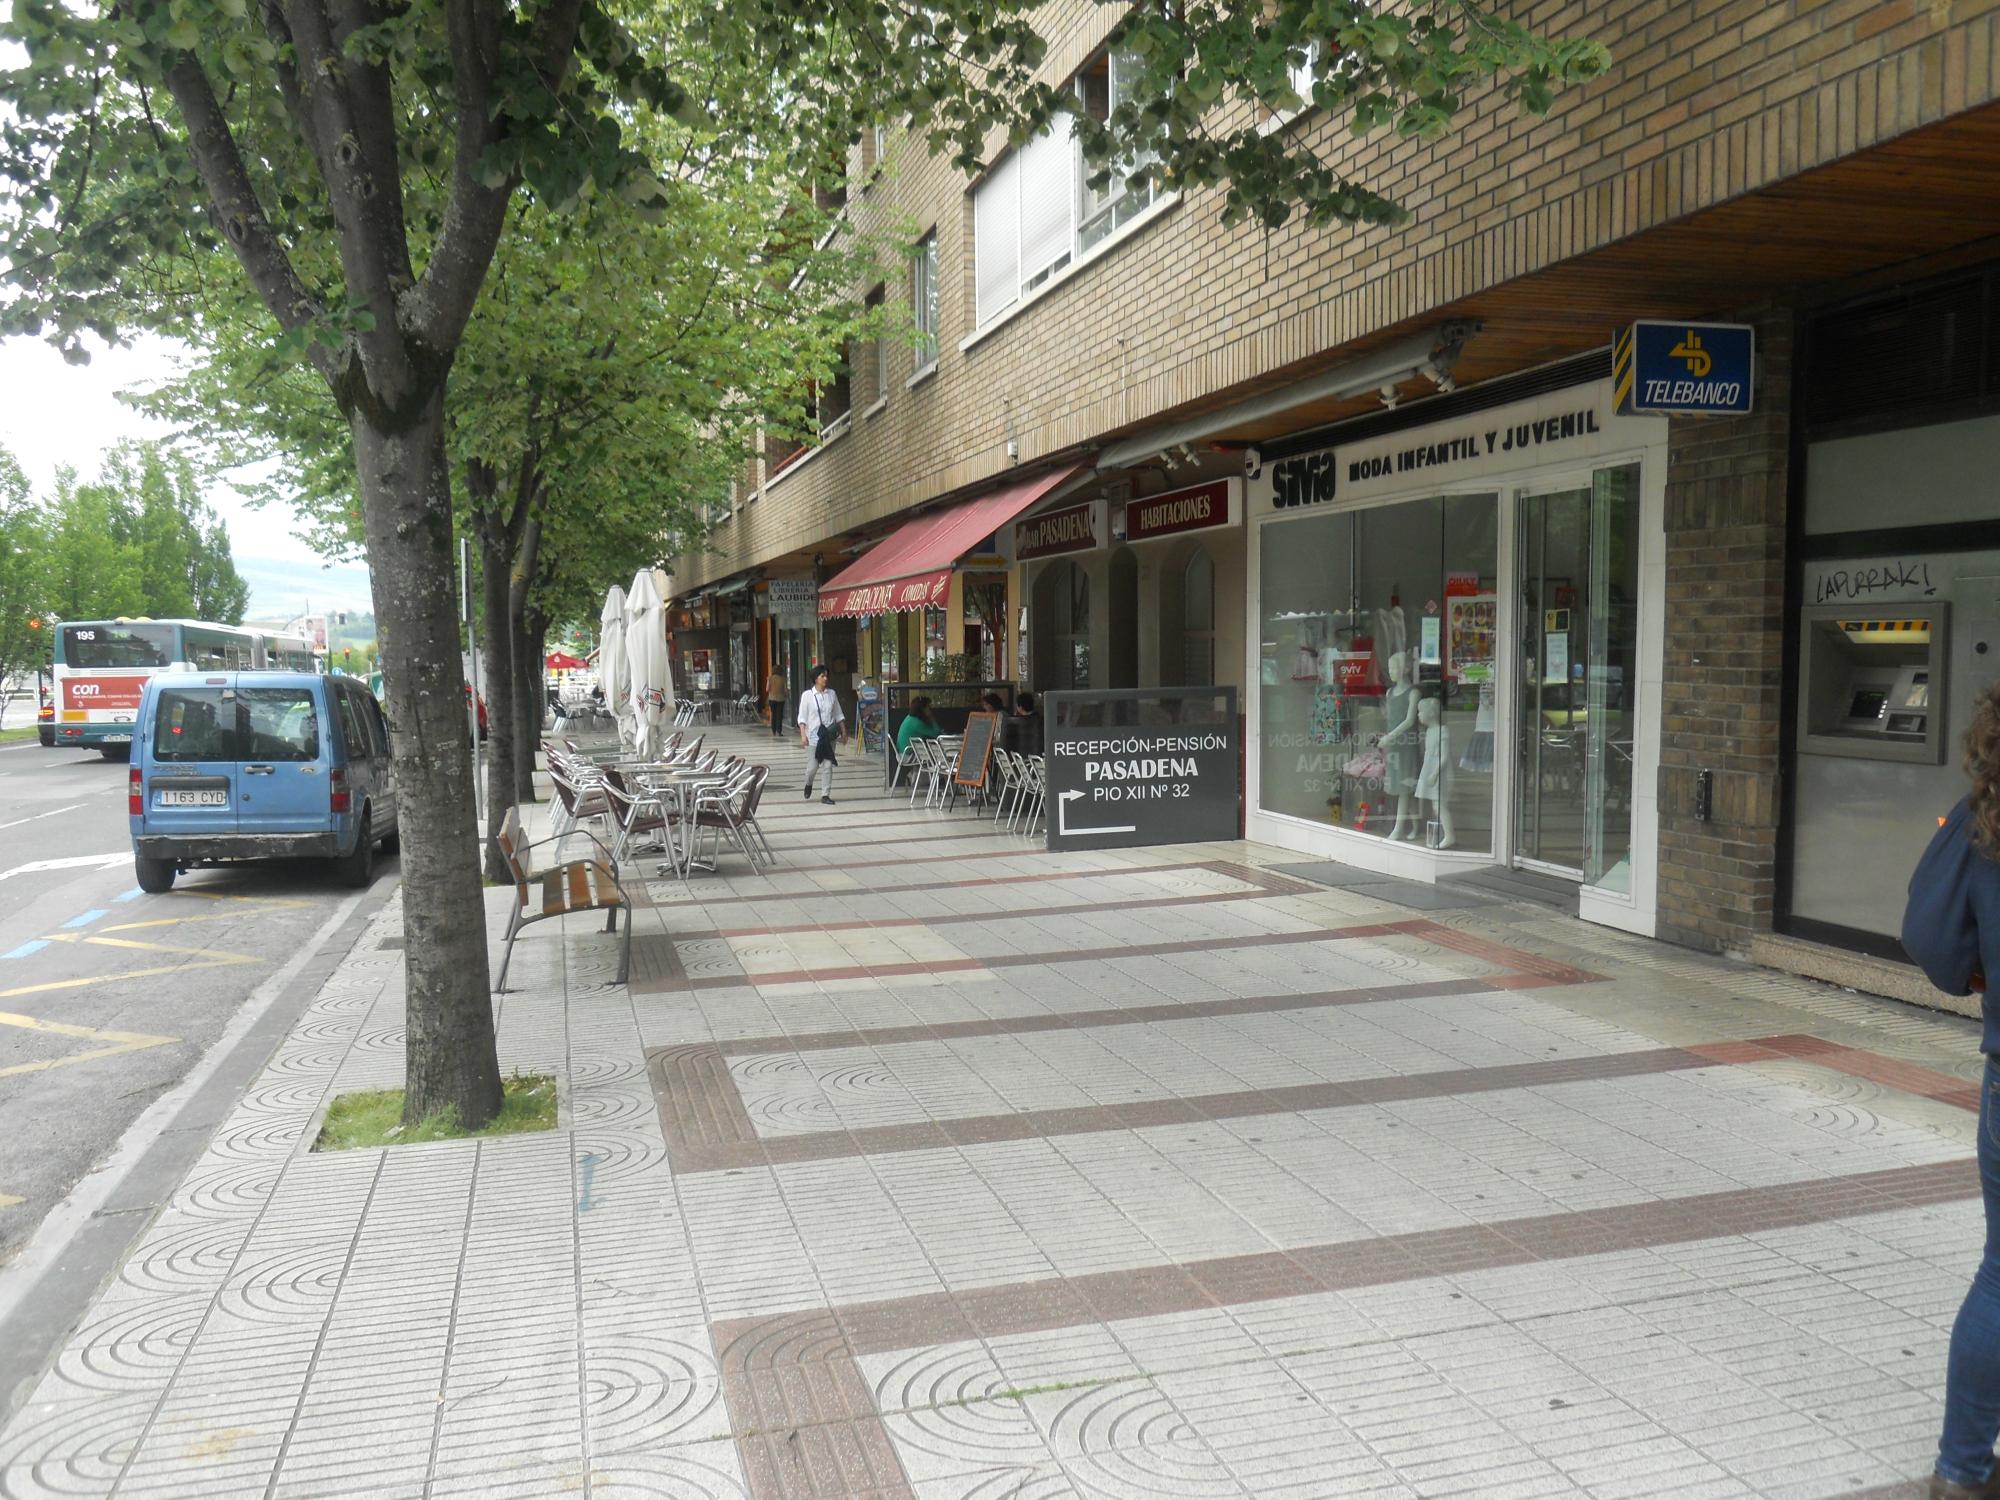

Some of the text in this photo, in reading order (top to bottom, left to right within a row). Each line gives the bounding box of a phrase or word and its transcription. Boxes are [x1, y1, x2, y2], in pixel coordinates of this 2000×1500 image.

[1645, 380, 1740, 405] TELEBANCO
[1349, 410, 1600, 482] MODA INFANTIL Y JUVENIL
[1140, 495, 1211, 530] HABITACIONES
[1040, 511, 1090, 547] PASADENA
[769, 593, 817, 601] LAUBIDE
[844, 584, 896, 611] HABITACIONES
[76, 630, 95, 640] 195
[72, 684, 100, 695] con
[1054, 733, 1227, 756] RECEPCIÓN-PENSIÓN
[1085, 757, 1199, 782] PASADENA
[165, 791, 224, 803] 1163 CYD
[1094, 783, 1190, 801] PIO XII Nº 32
